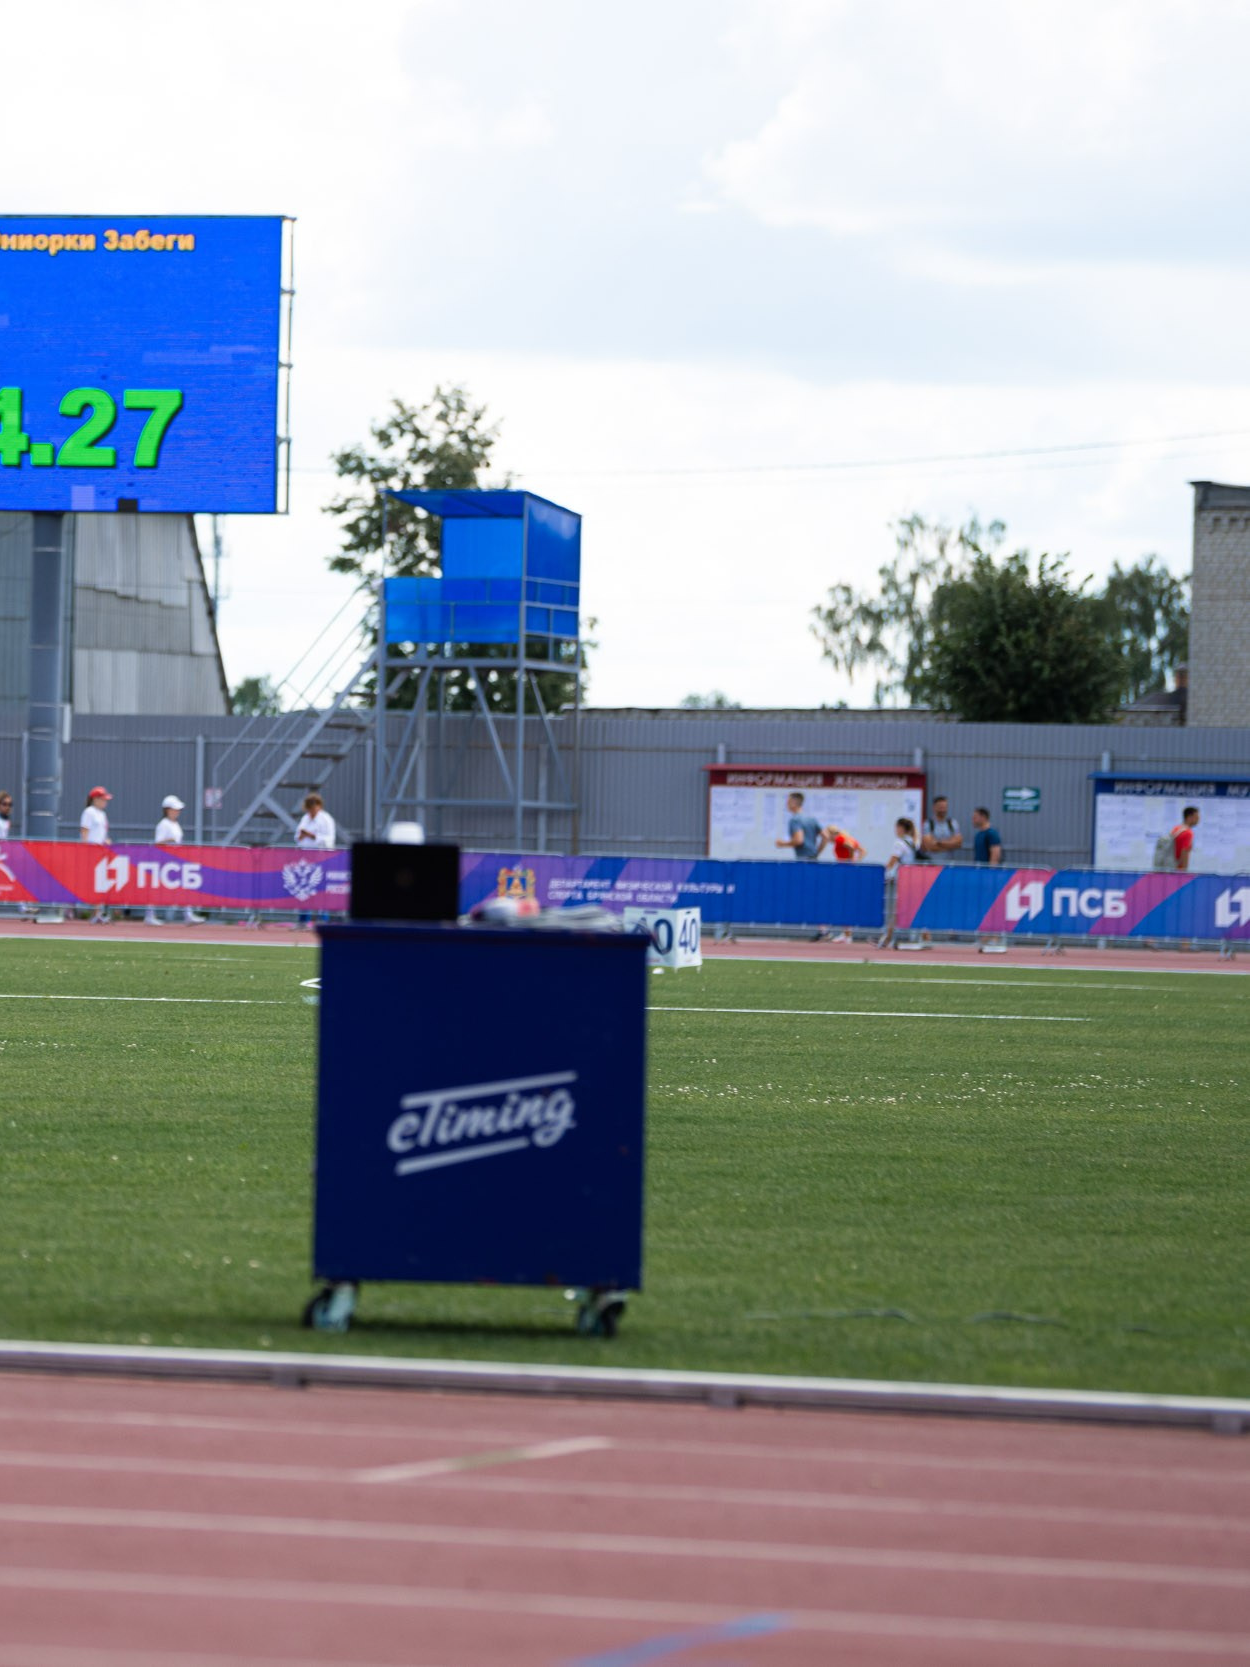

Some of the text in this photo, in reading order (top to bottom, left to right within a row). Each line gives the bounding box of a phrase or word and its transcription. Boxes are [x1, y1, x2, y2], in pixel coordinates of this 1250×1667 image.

[104, 229, 195, 251] Забеги
[726, 772, 908, 788] ИНФОРМАЦИЯ ЖЕНЩИНЫ
[136, 861, 203, 890] ПСБ
[1052, 886, 1127, 919] ПСБ
[678, 918, 698, 955] 40
[386, 1072, 578, 1153] eTiming
